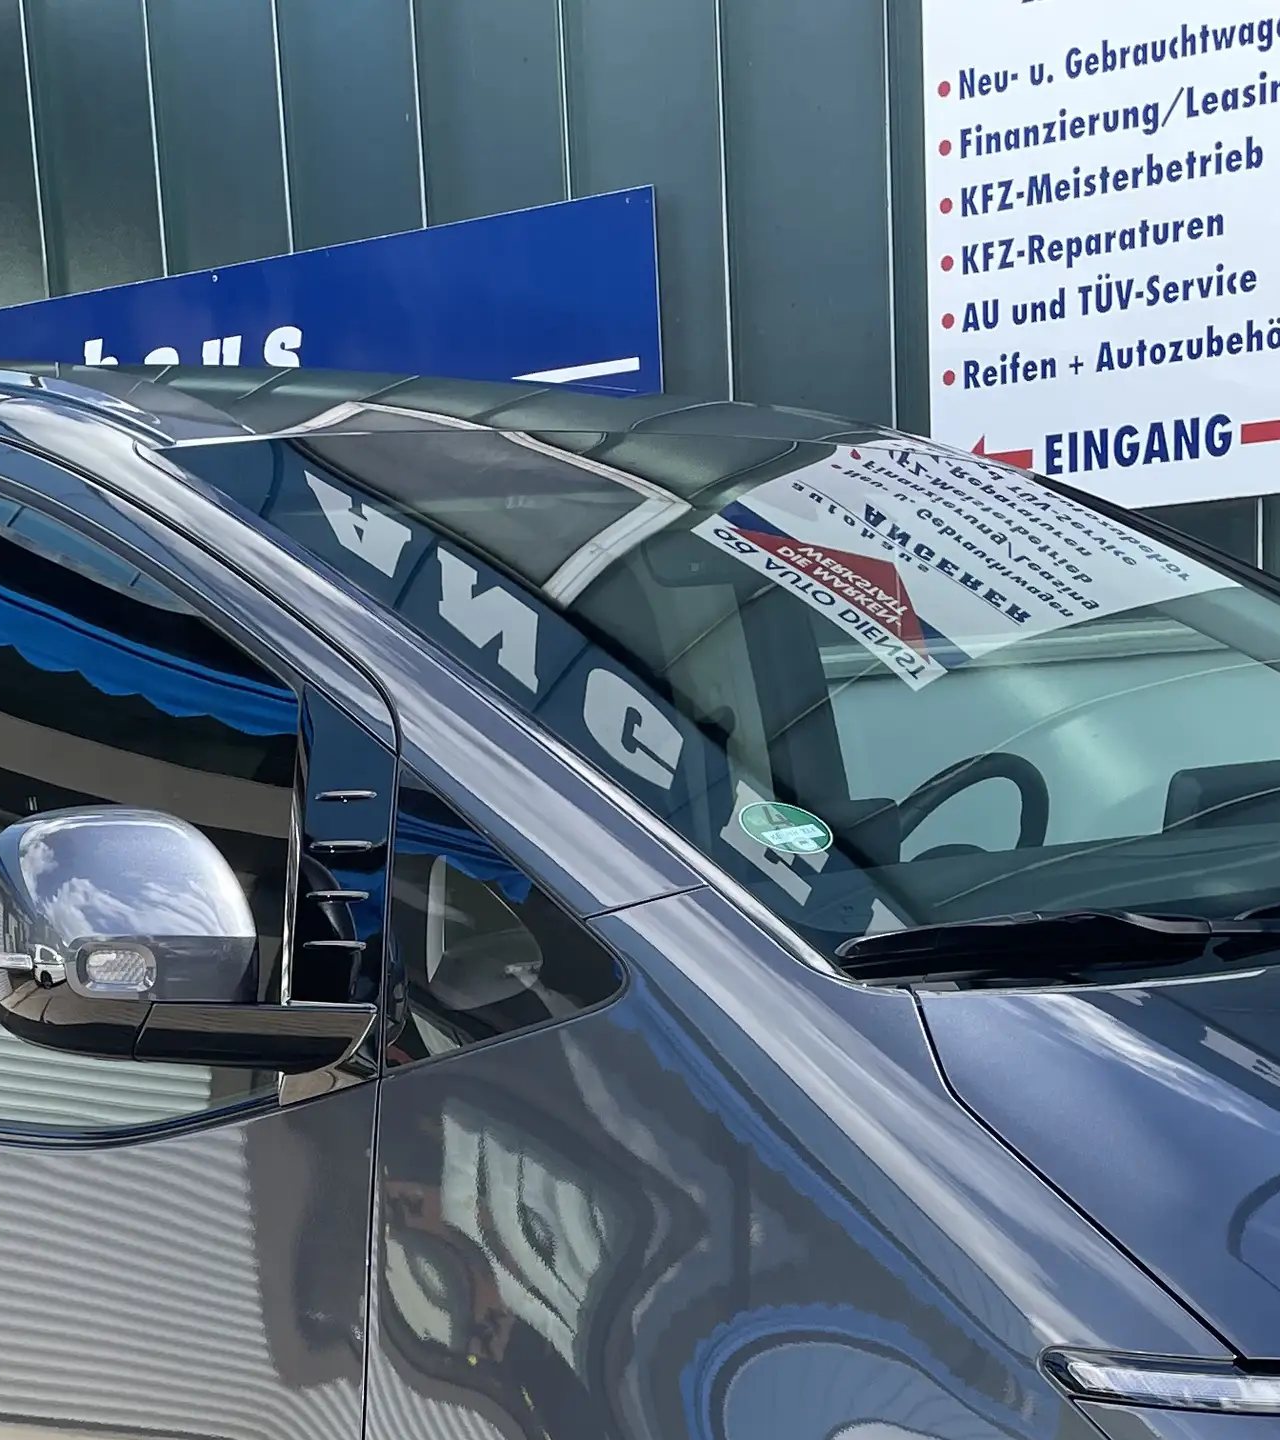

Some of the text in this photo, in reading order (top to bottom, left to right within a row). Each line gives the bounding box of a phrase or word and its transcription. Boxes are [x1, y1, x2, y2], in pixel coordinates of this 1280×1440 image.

[958, 68, 1019, 100] Neu-
[1029, 61, 1054, 87] u.
[960, 136, 1264, 218] KFZ-Meisterbetrieb
[961, 212, 1225, 275] KFZ-Reparaturen
[962, 263, 1257, 333] AU und TÜV-Service
[963, 351, 1058, 389] Reifen
[1045, 413, 1234, 476] EINGANG
